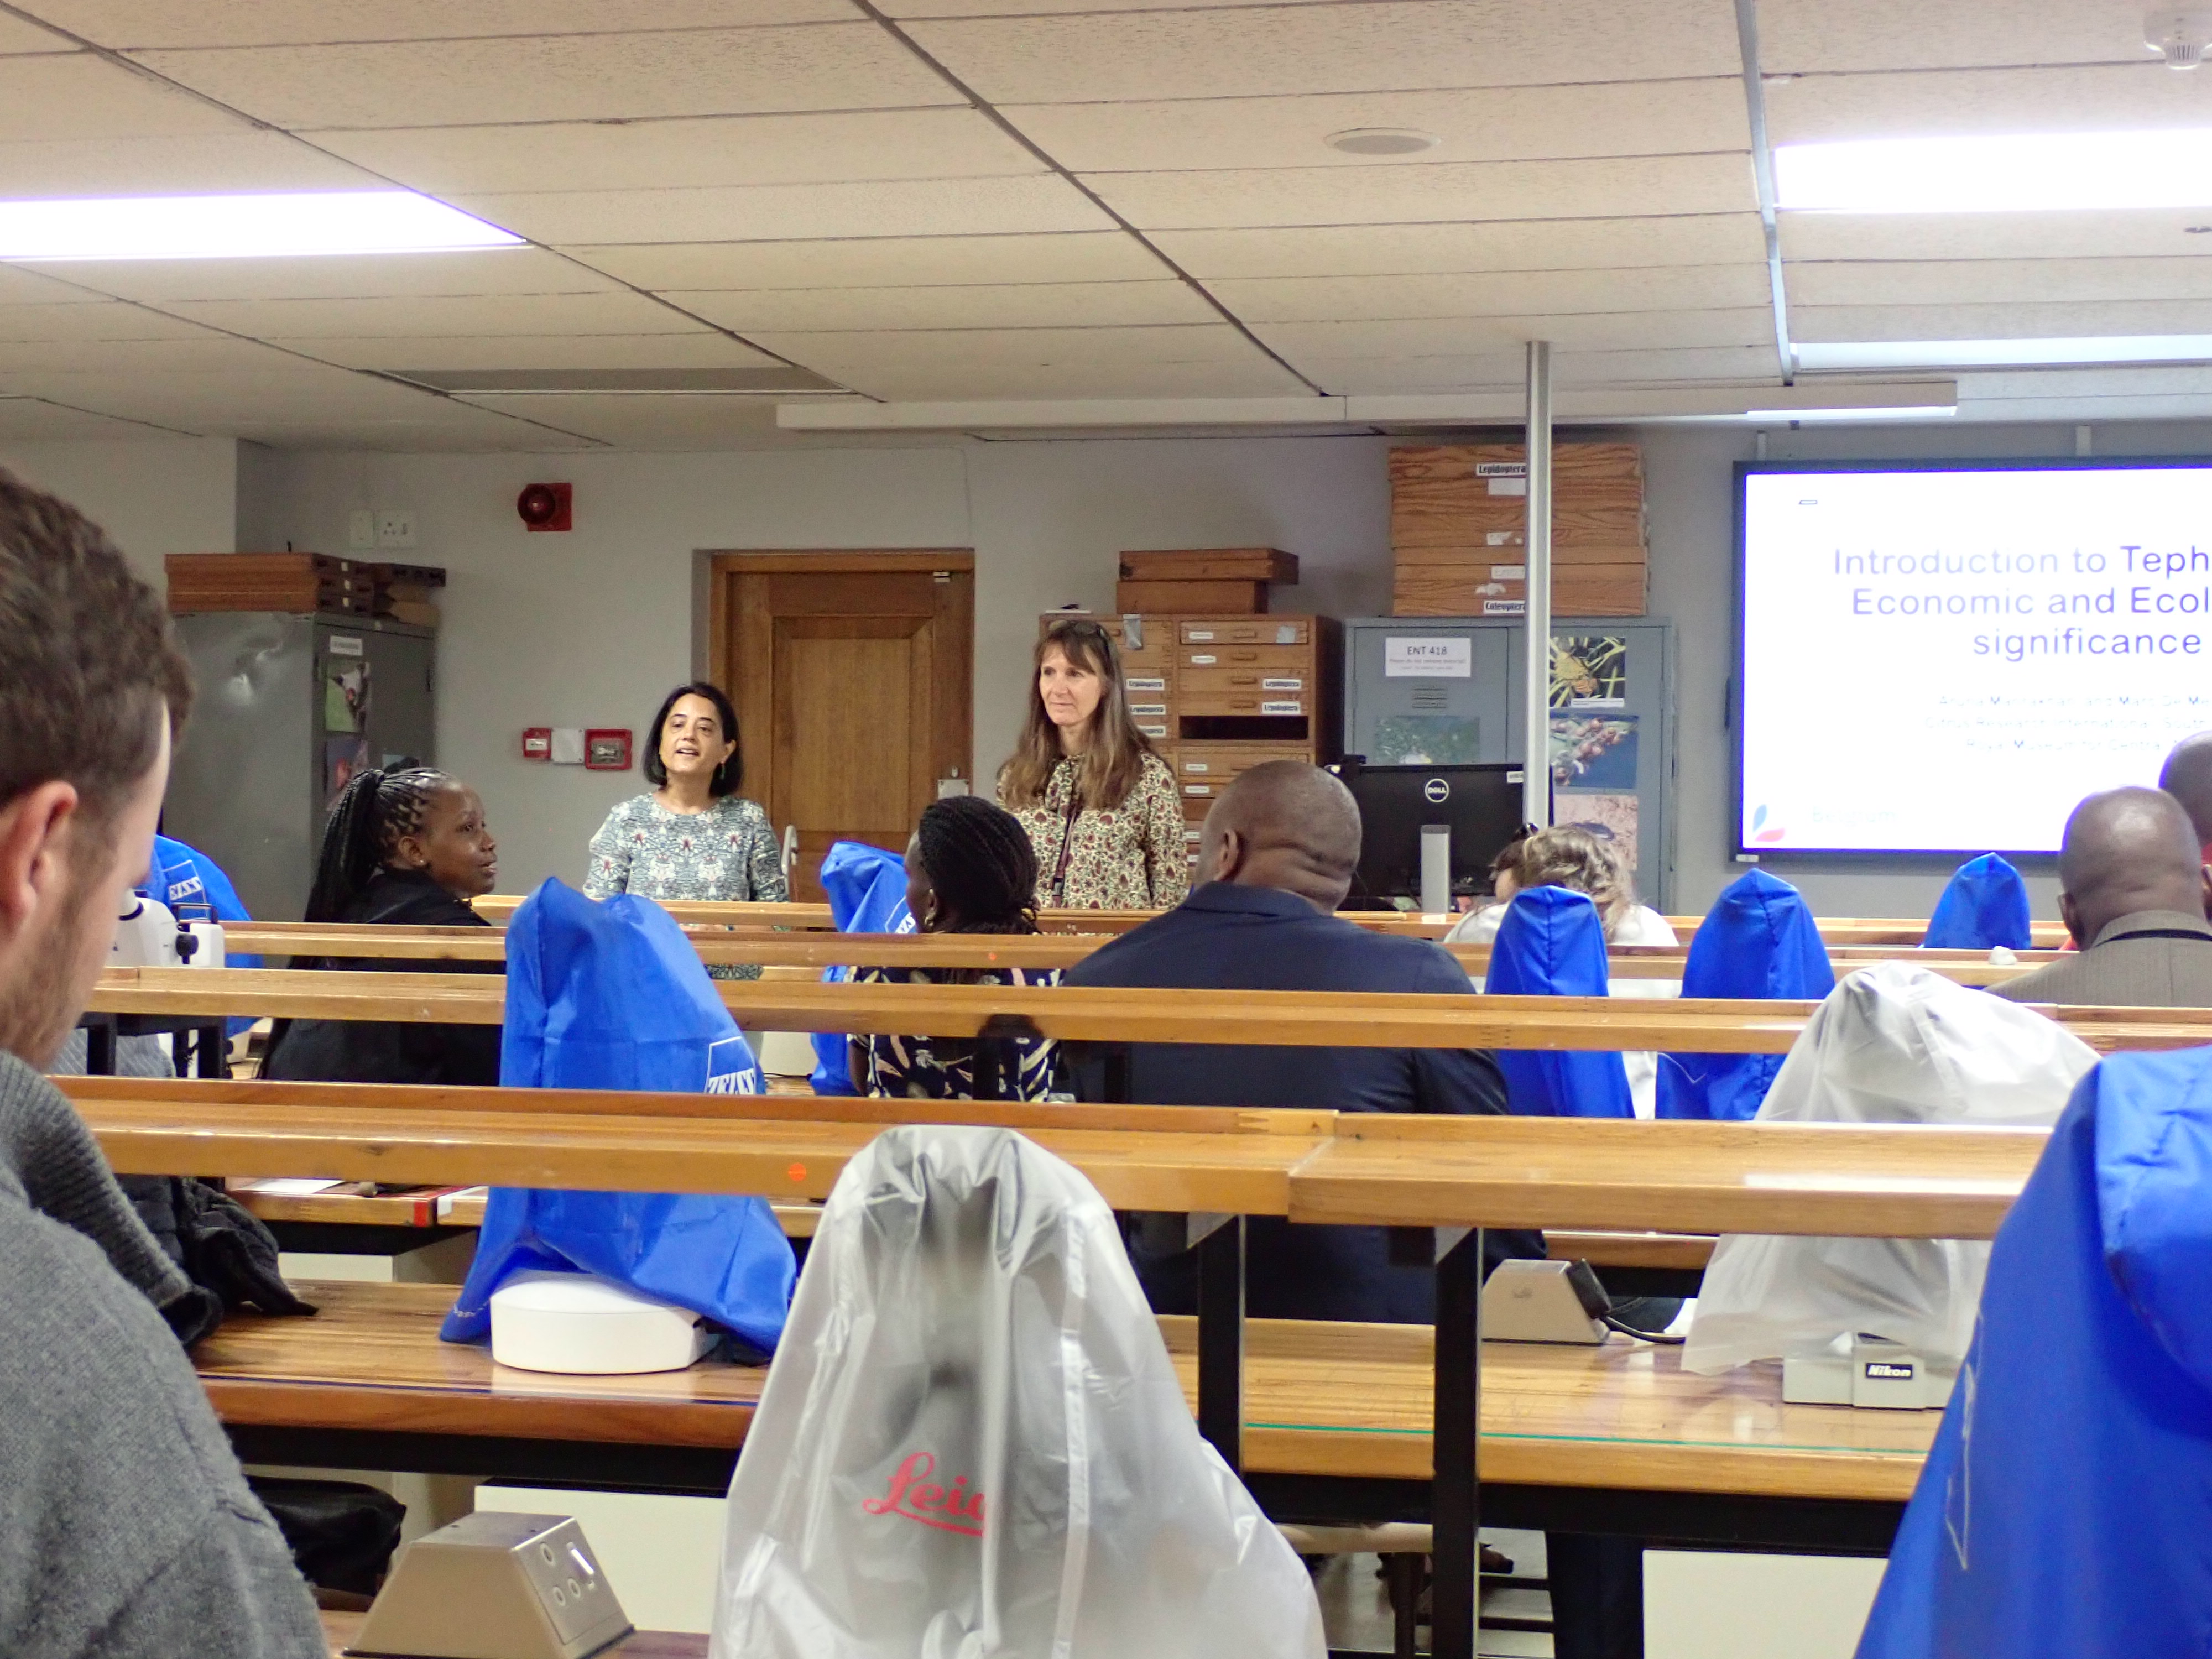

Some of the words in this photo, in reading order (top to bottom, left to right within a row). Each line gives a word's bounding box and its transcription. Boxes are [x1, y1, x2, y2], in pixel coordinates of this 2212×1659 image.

[1834, 548, 2058, 575] Introduction
[2073, 548, 2107, 574] to
[2119, 544, 2210, 581] Teph
[1852, 587, 2034, 615] Economic
[2047, 586, 2116, 615] and
[2130, 585, 2211, 614] Ecol
[1407, 646, 1427, 655] ENT
[1429, 646, 1447, 655] 418
[1973, 626, 2203, 663] significance
[2107, 739, 2163, 750] Centra
[1867, 1364, 1912, 1378] Nikon
[861, 1451, 987, 1538] Leic
